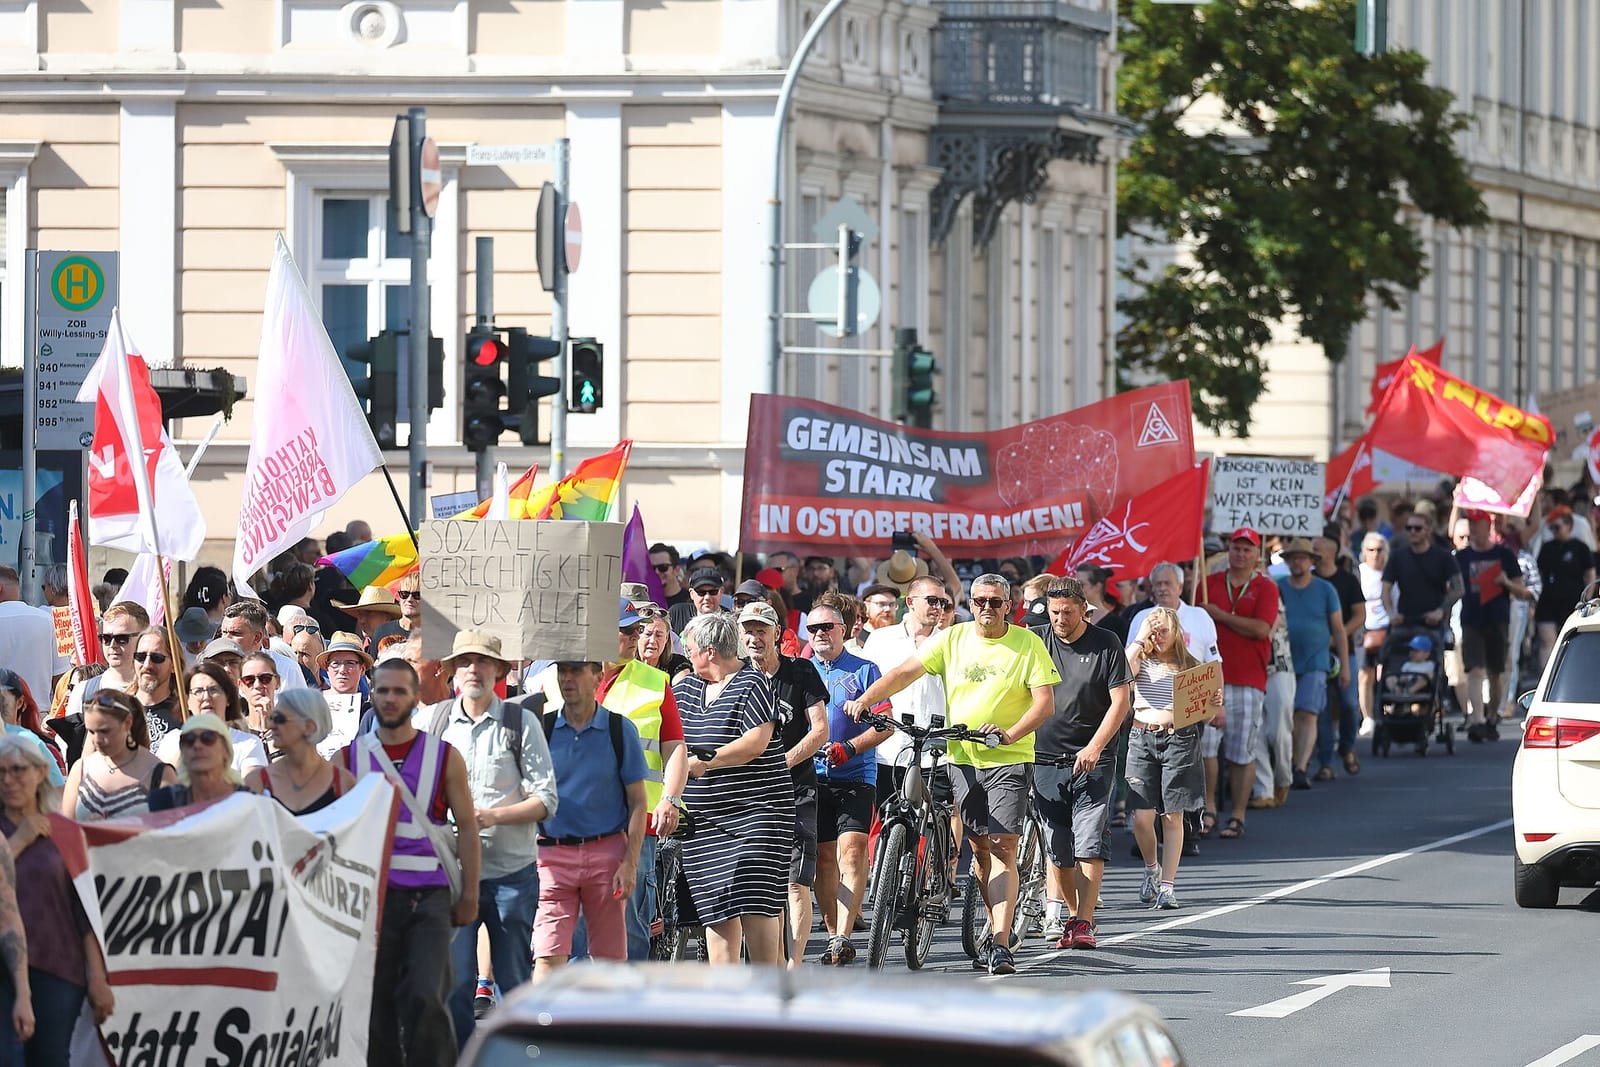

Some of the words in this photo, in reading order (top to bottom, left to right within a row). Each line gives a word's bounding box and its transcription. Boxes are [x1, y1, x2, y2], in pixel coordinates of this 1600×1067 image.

[66, 268, 89, 300] H
[40, 329, 107, 339] (Willy-Lessing-St
[67, 319, 87, 328] ZOB
[40, 363, 59, 373] 940
[39, 381, 58, 391] 941
[39, 399, 58, 409] 952
[1442, 380, 1549, 445] MLPD
[39, 417, 58, 427] 995
[787, 416, 982, 477] GEMEINSAM
[825, 459, 936, 501] STARK
[1237, 477, 1257, 489] IST
[1270, 478, 1304, 491] KEIN
[1214, 493, 1320, 509] WIRTSCHAFTS
[758, 504, 789, 534] IN
[796, 502, 1085, 541] OSTOBERFRANKEN!
[1228, 509, 1309, 531] FAKTOR
[430, 519, 551, 554] SOZIALE
[421, 553, 620, 592] GERECHTIGKEIT
[517, 591, 591, 627] ALLE
[1176, 666, 1216, 690] Zukunft
